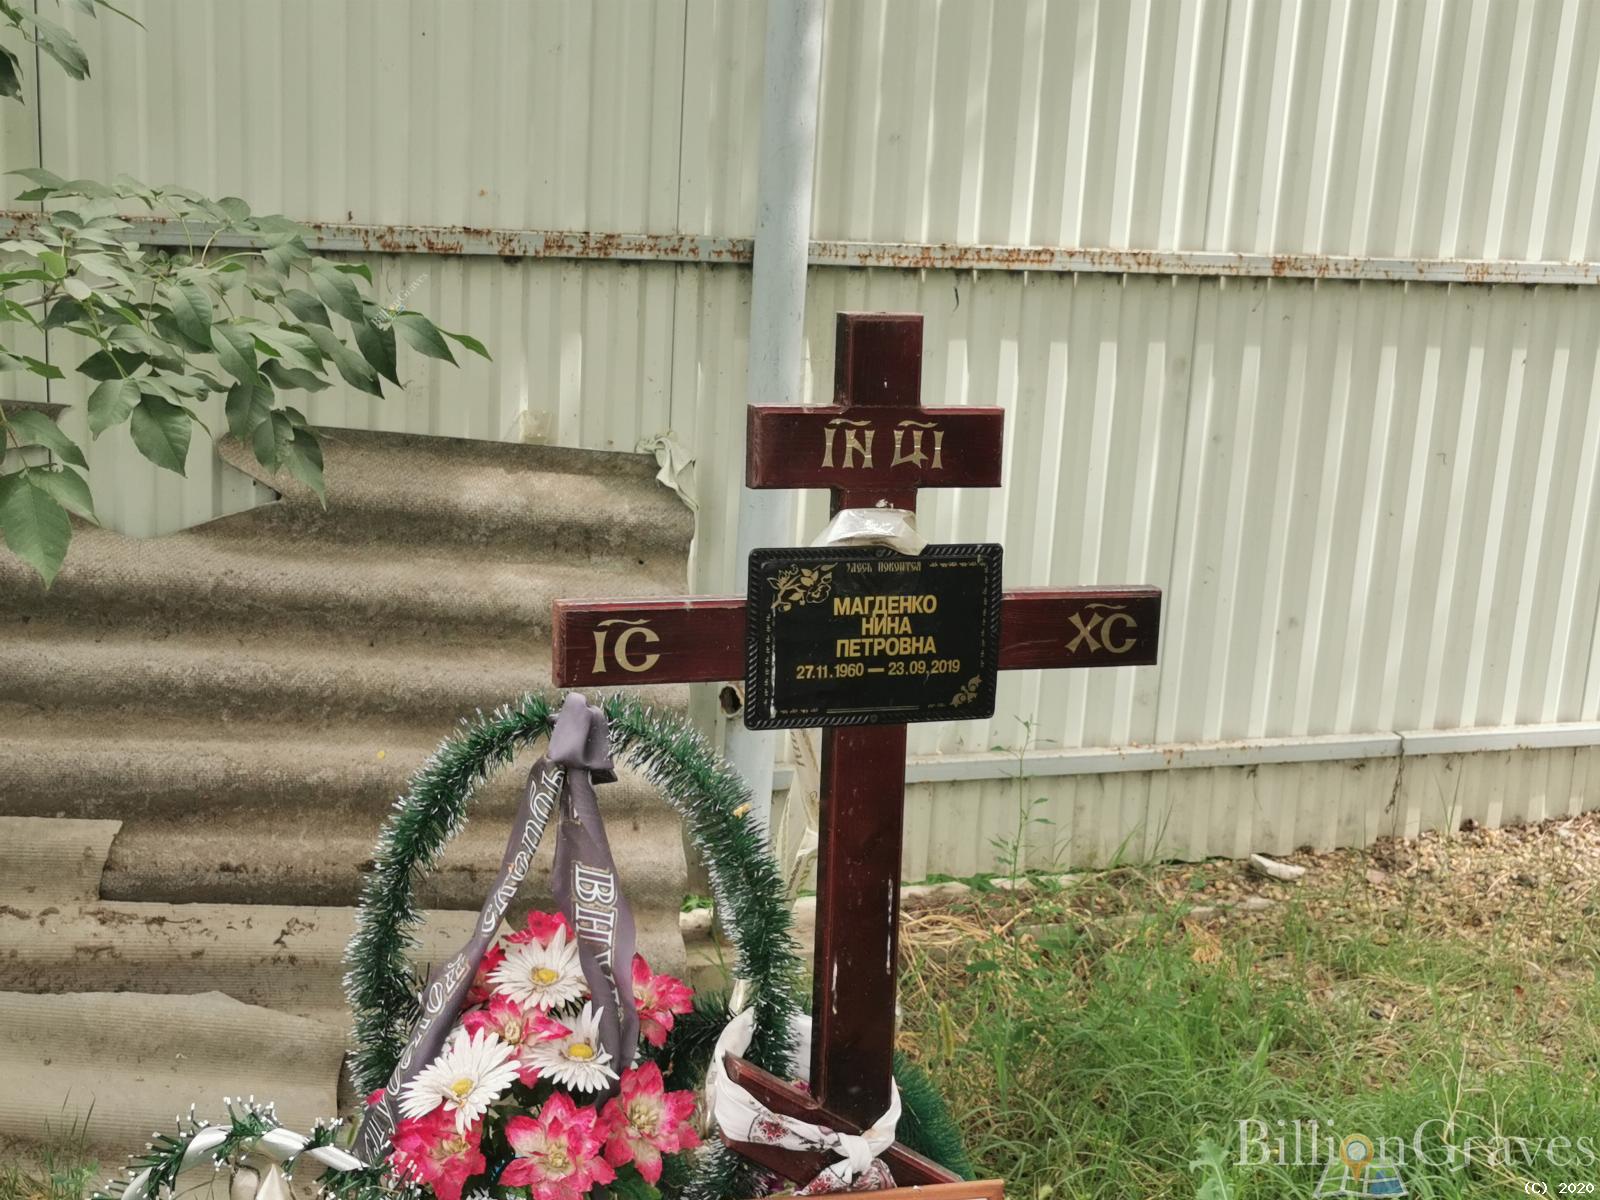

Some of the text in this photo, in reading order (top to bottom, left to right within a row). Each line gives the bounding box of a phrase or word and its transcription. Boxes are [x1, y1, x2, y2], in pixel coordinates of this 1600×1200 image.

[833, 594, 937, 617] МАГДЕНКО
[861, 616, 912, 636] НИНА
[836, 636, 937, 658] ПЕТРОВНА
[796, 662, 864, 680] 27.11.1960
